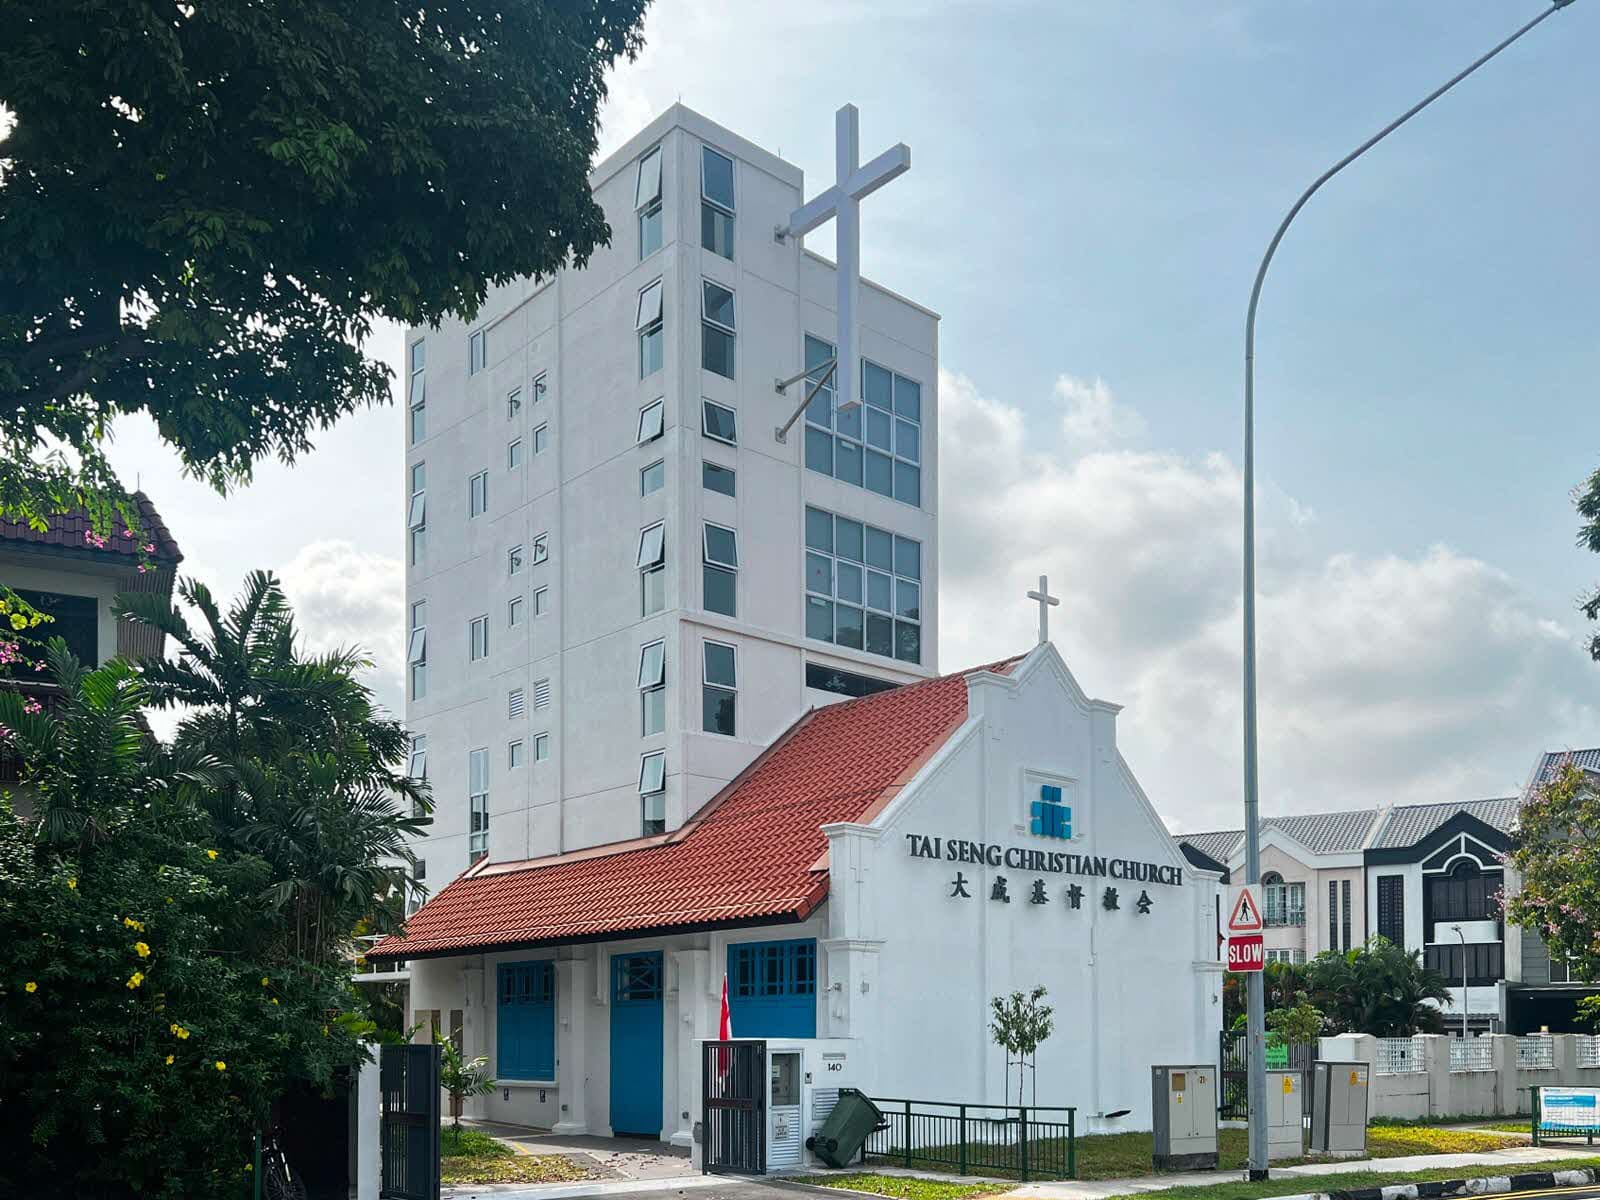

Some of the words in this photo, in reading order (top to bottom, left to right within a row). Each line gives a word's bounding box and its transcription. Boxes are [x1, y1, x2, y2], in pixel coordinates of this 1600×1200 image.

[906, 834, 942, 859] TAI
[947, 839, 1003, 867] SENG
[1005, 847, 1107, 877] CHRISTIAN
[1109, 859, 1183, 886] CHURCH
[1229, 943, 1263, 964] SLOW
[828, 1063, 843, 1072] 140
